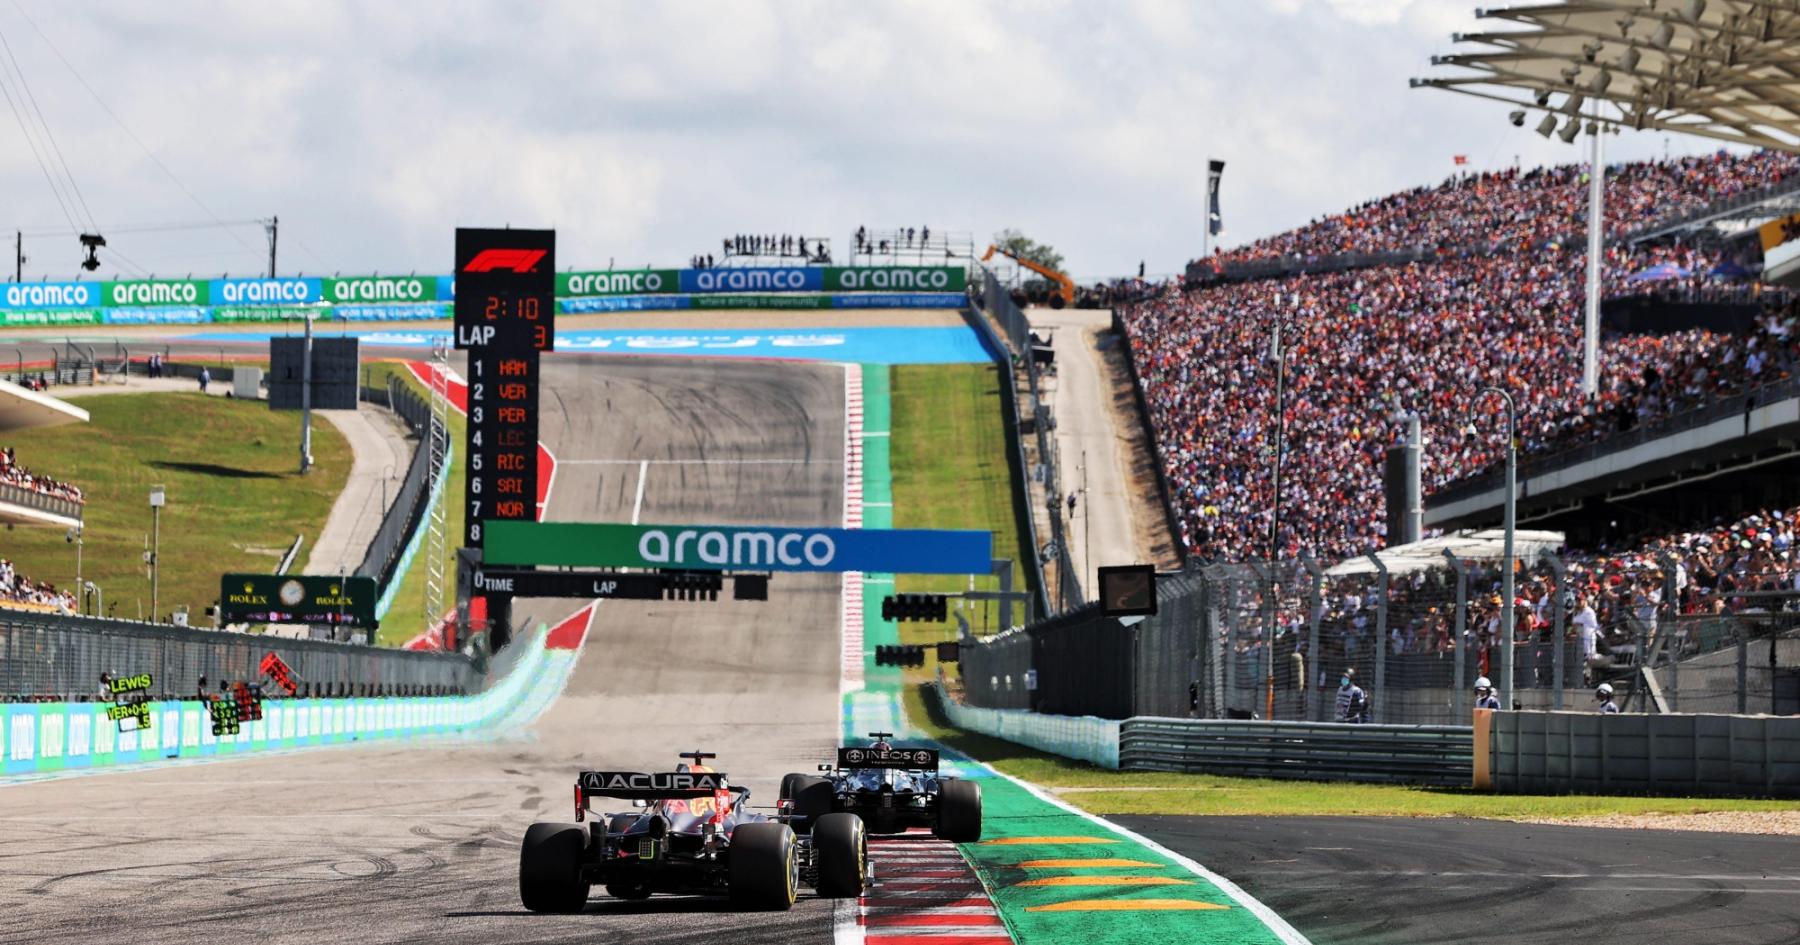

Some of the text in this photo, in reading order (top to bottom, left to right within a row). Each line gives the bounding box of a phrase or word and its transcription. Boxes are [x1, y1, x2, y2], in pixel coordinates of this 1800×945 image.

[568, 273, 662, 292] aramco
[697, 270, 805, 289] aramco
[840, 269, 948, 288] aramco
[7, 285, 89, 306] aramco
[113, 283, 197, 304] aramco
[223, 280, 308, 301] aramco
[335, 279, 422, 299] aramco
[486, 297, 539, 320] 2:10
[459, 325, 496, 345] LAP
[534, 325, 546, 348] 3
[474, 360, 527, 377] 1 HAM
[473, 383, 527, 400] 2 VER
[473, 406, 526, 423] 3 PER
[472, 430, 525, 447] 4 LEC
[472, 454, 524, 470] 5 RIC
[472, 477, 523, 493] 6 SAI
[472, 501, 524, 517] 7 NOR
[471, 524, 480, 541] 8
[638, 529, 836, 567] aramco
[484, 578, 514, 592] TIME
[593, 580, 617, 593] LAP
[229, 594, 268, 604] ROLEX
[316, 596, 353, 605] ROLEX
[111, 674, 151, 693] LEWIS
[866, 750, 912, 760] INEOS
[607, 774, 718, 790] ACURA
